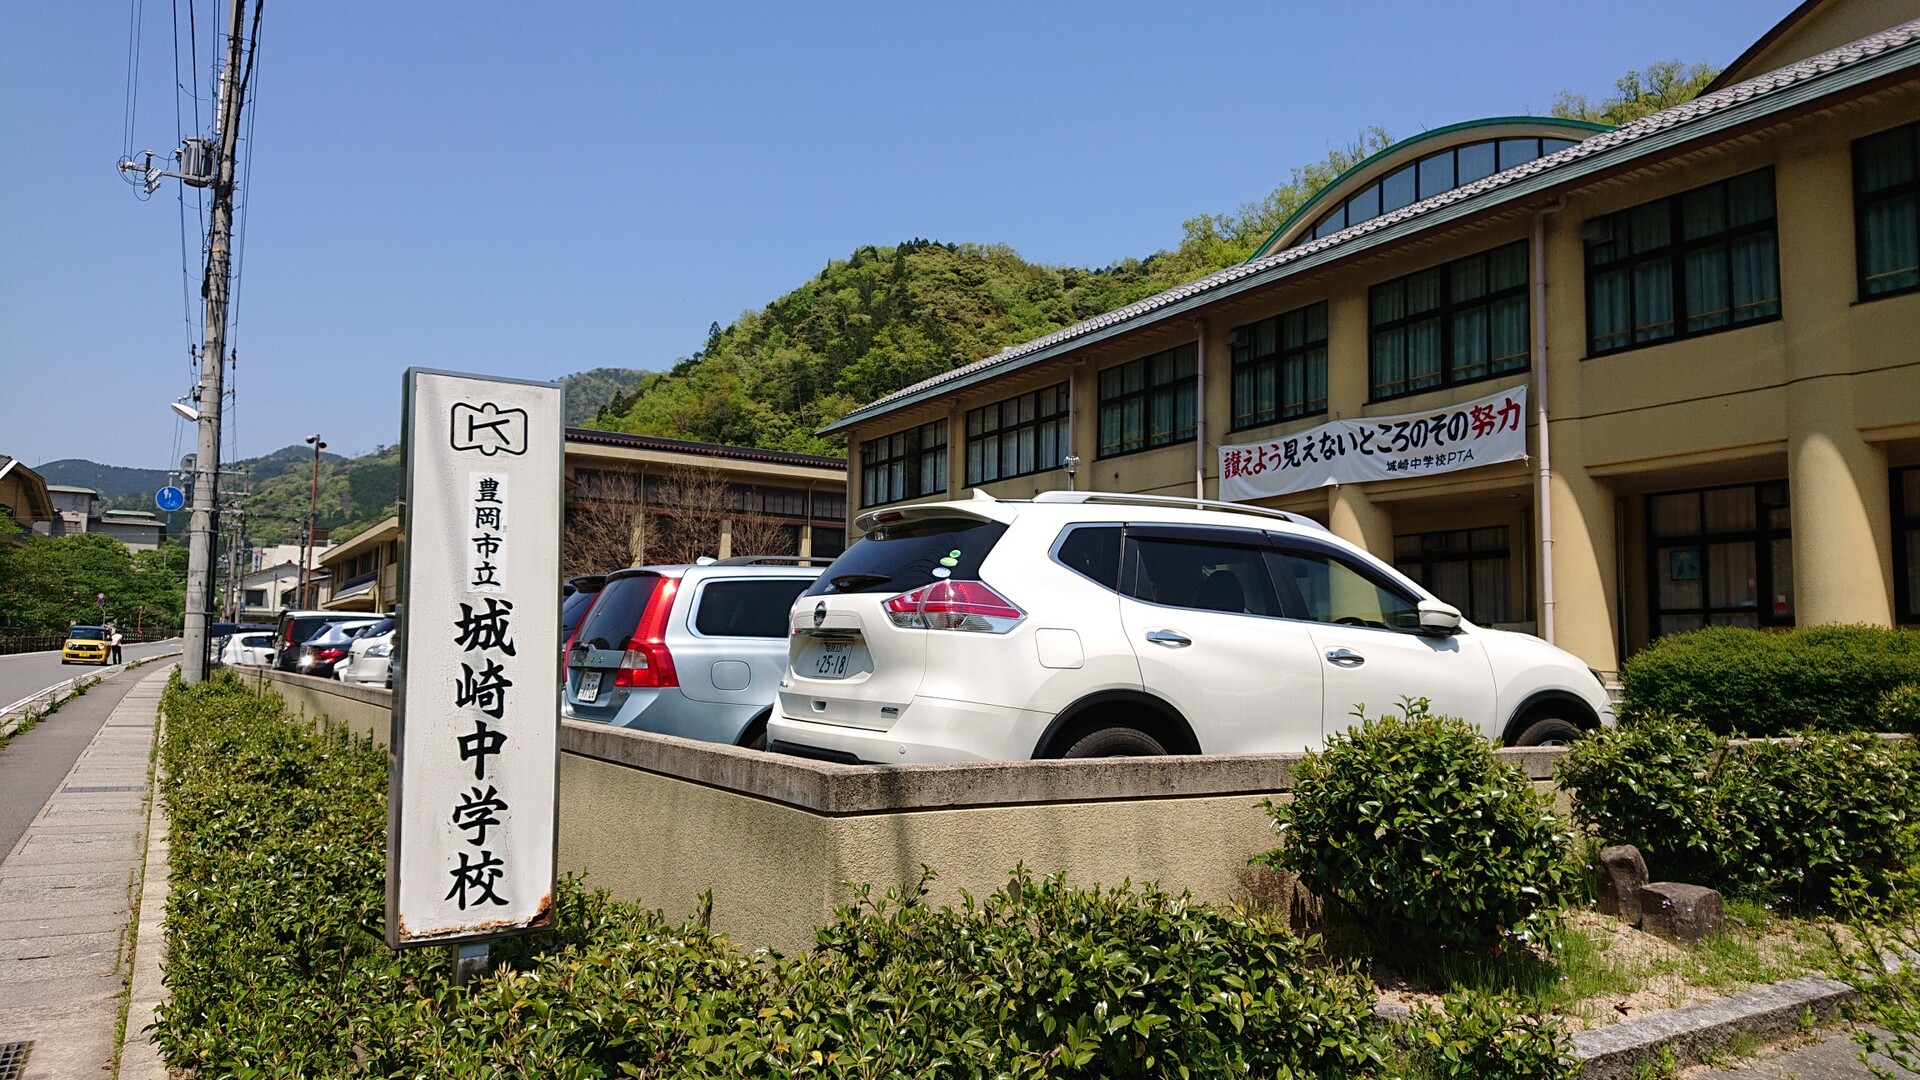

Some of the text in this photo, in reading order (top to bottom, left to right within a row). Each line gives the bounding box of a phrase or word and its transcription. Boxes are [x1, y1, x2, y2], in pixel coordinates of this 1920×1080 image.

[1386, 448, 1474, 472] 城崎中学校PTA
[471, 477, 503, 587] 豊岡市立
[444, 597, 517, 911] 城崎中学校
